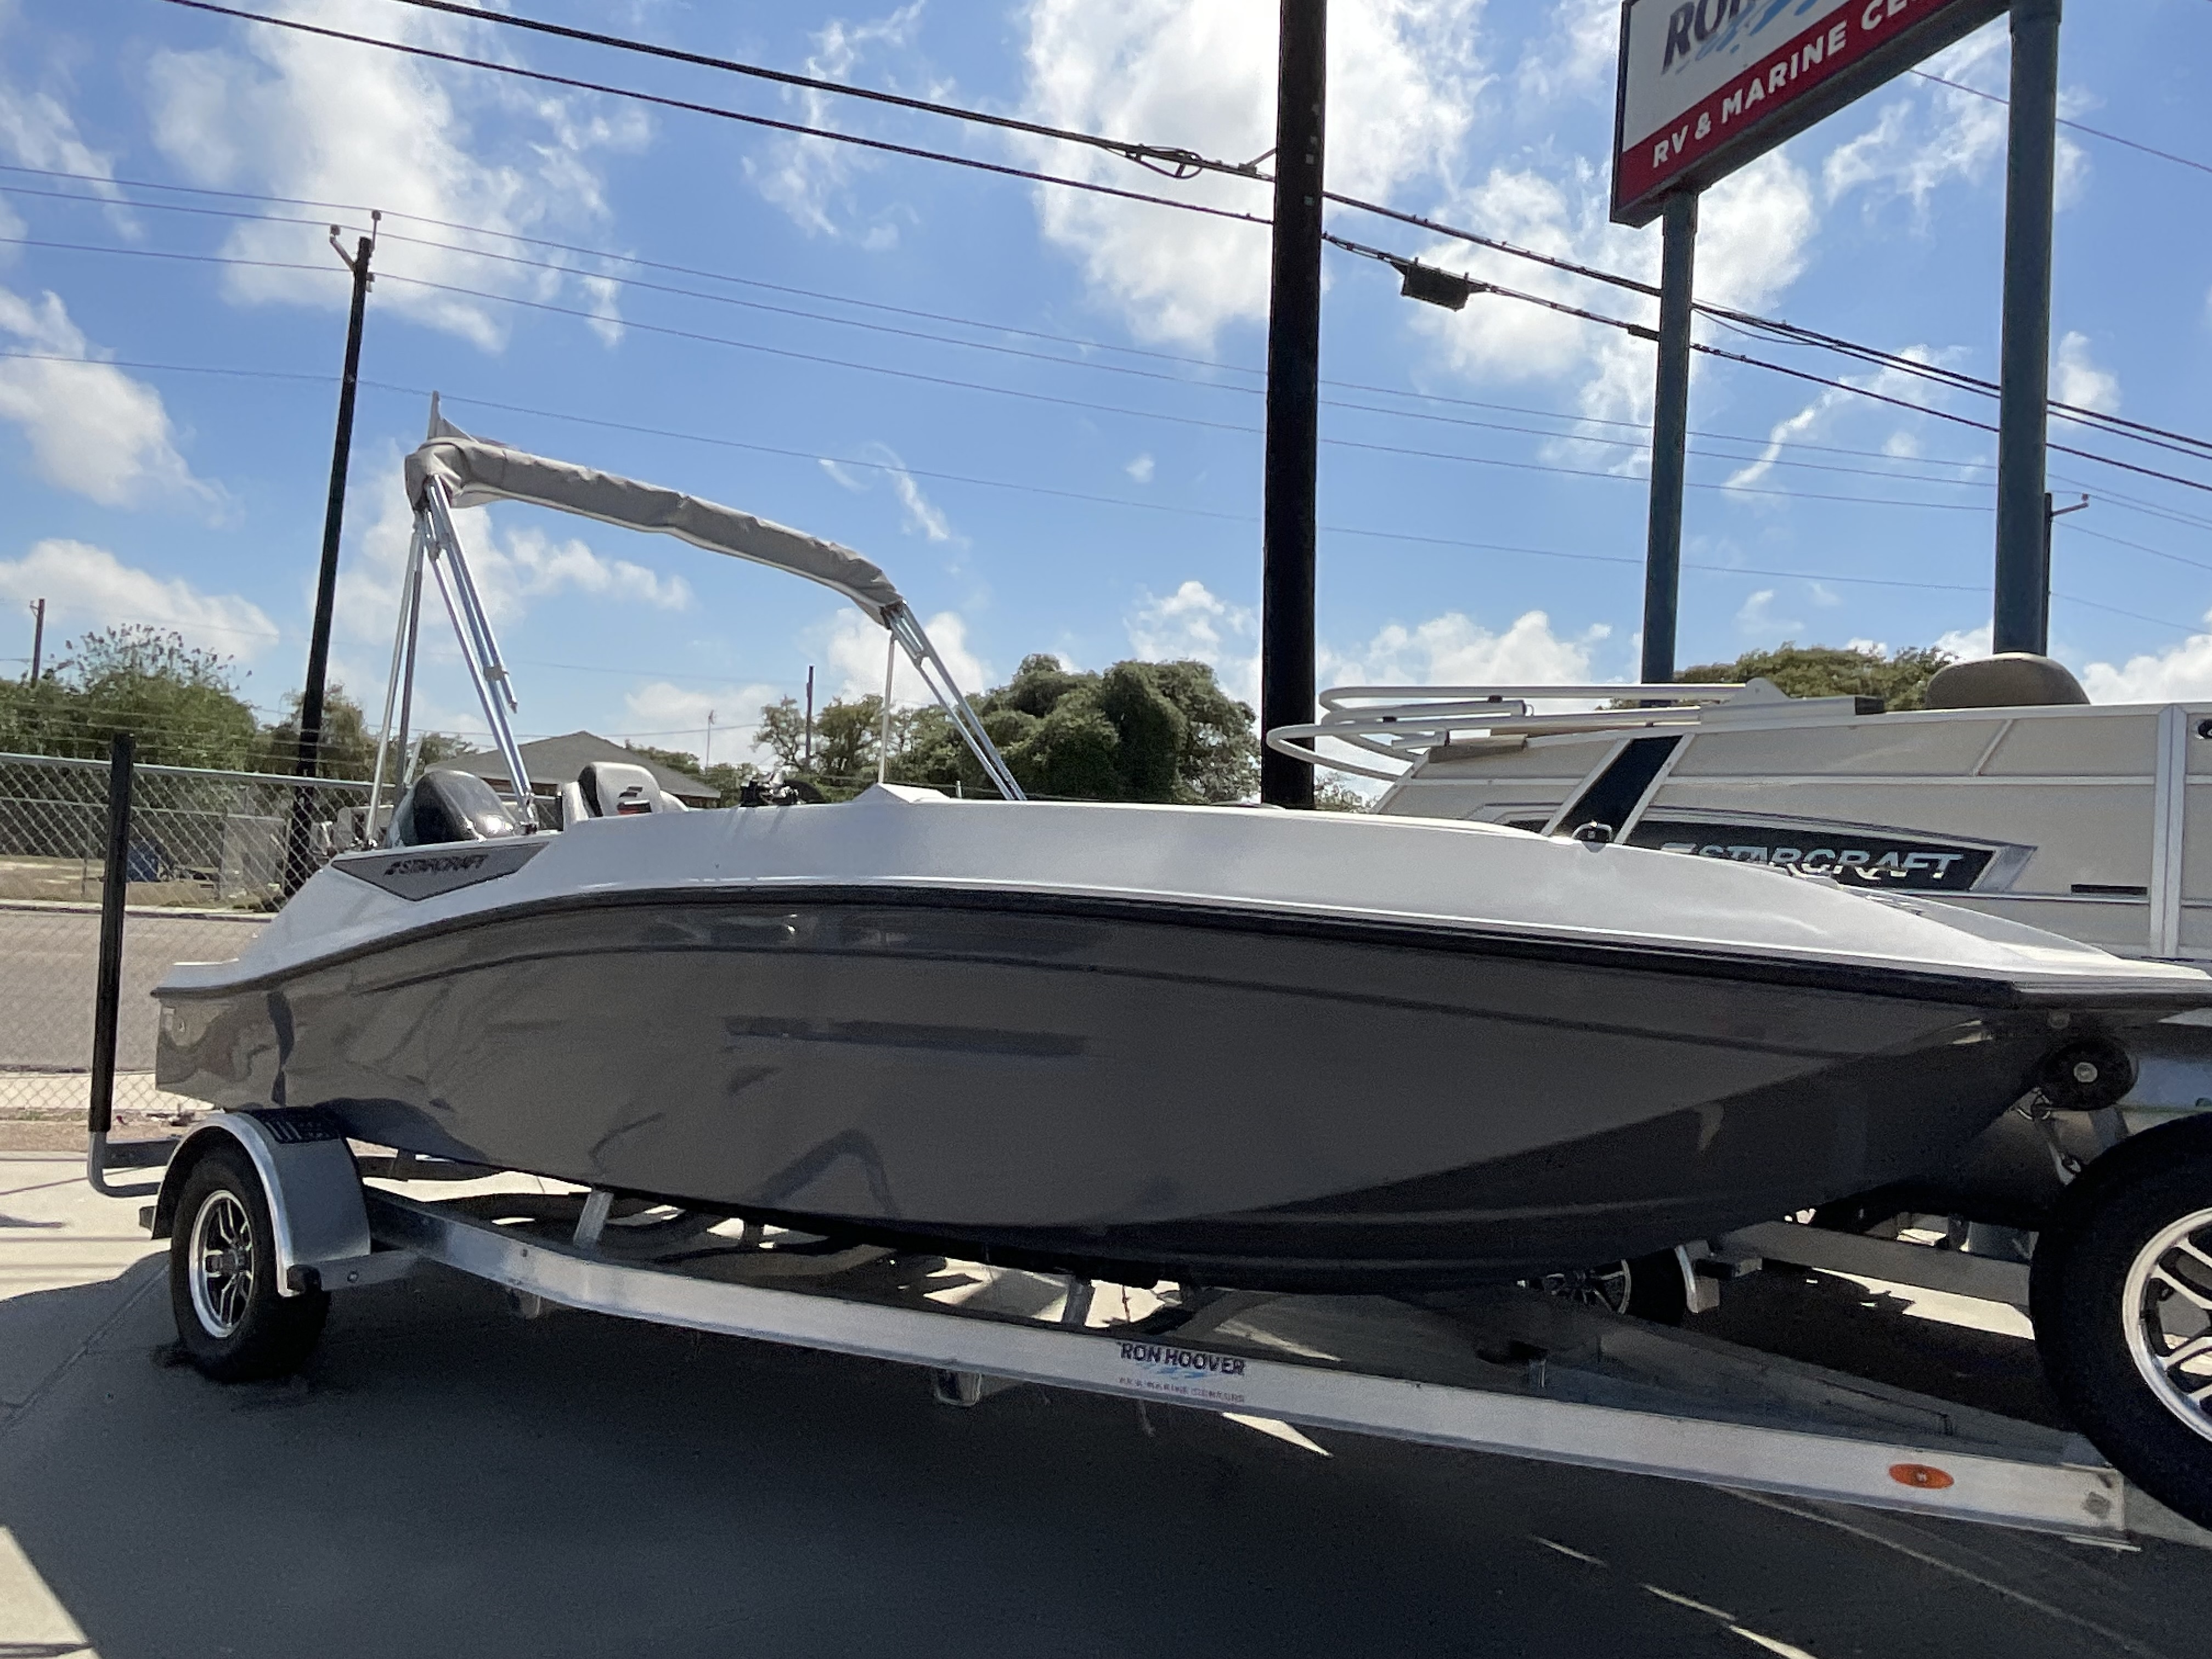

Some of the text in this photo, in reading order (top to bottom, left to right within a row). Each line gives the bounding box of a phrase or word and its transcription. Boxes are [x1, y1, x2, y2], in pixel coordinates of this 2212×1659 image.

[1661, 0, 1740, 75] RO
[1653, 125, 1689, 168] RV
[1695, 112, 1711, 140] &
[1722, 20, 1847, 124] MARINE
[1120, 1343, 1245, 1375] RON HOOVER
